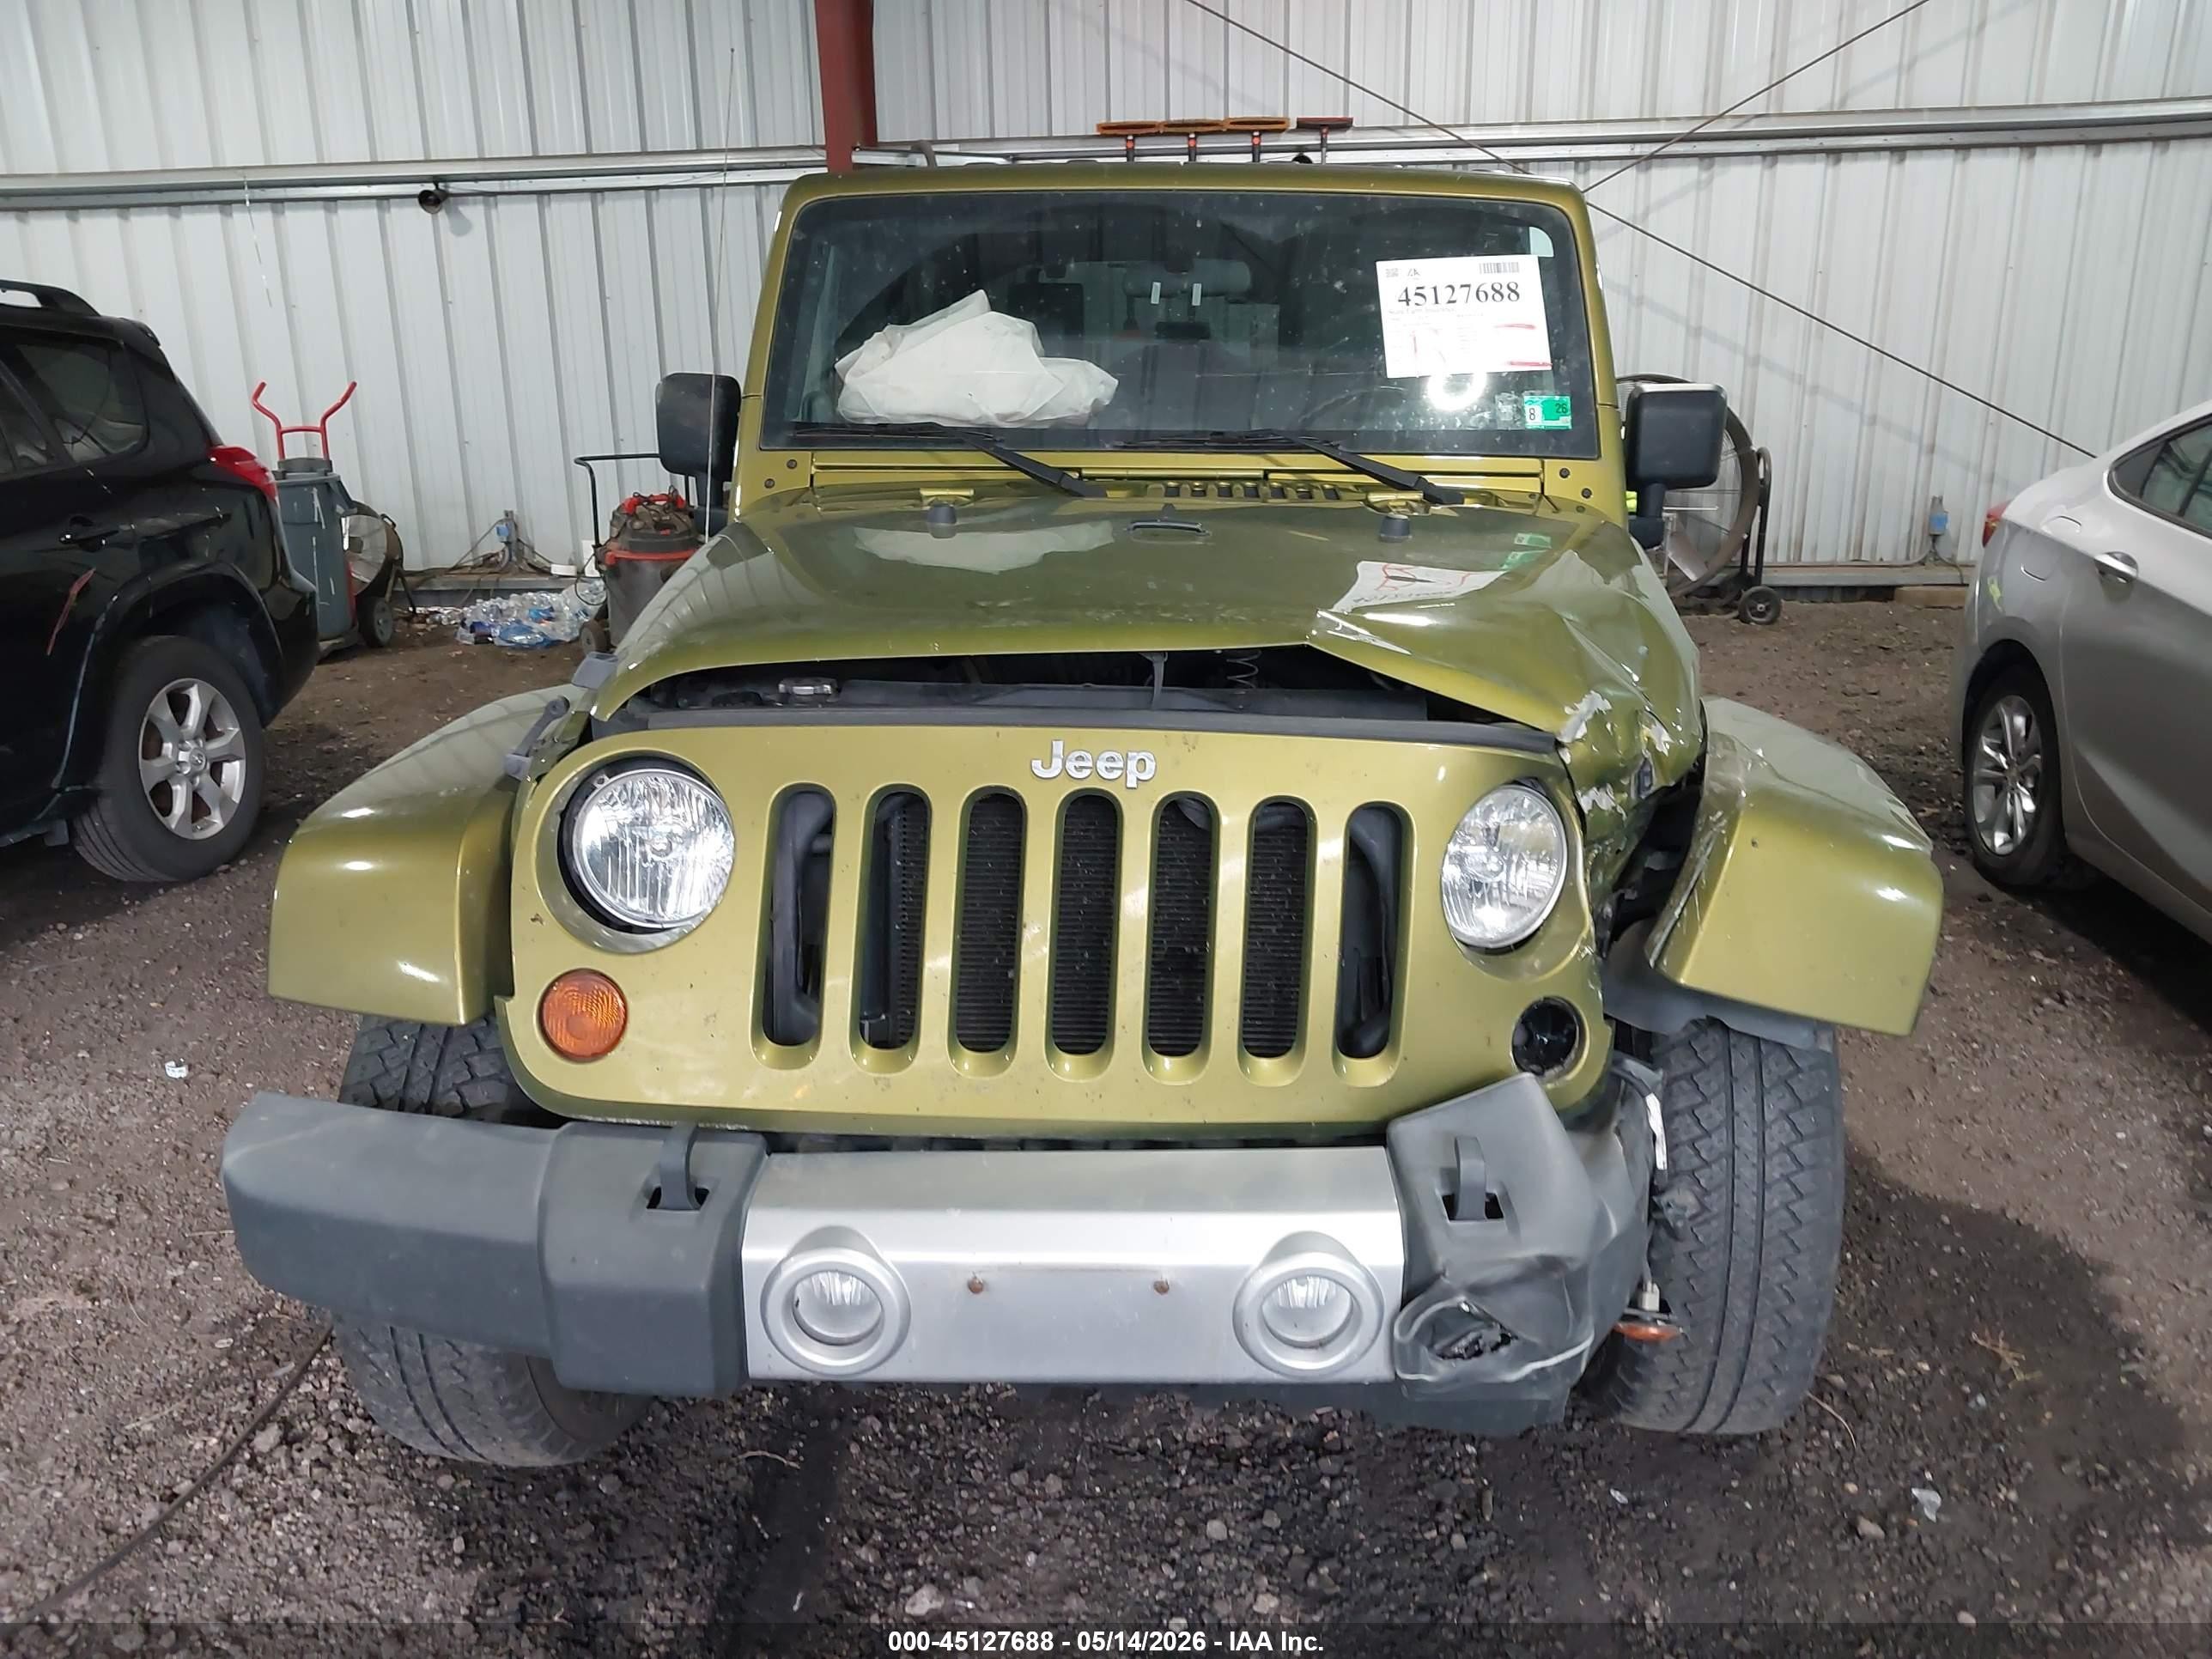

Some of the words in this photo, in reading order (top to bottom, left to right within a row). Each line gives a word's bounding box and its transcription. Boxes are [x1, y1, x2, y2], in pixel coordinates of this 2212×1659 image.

[1398, 282, 1521, 306] 45127688
[1528, 407, 1536, 421] 8
[1554, 403, 1568, 414] 26
[1030, 740, 1156, 788] Jeep
